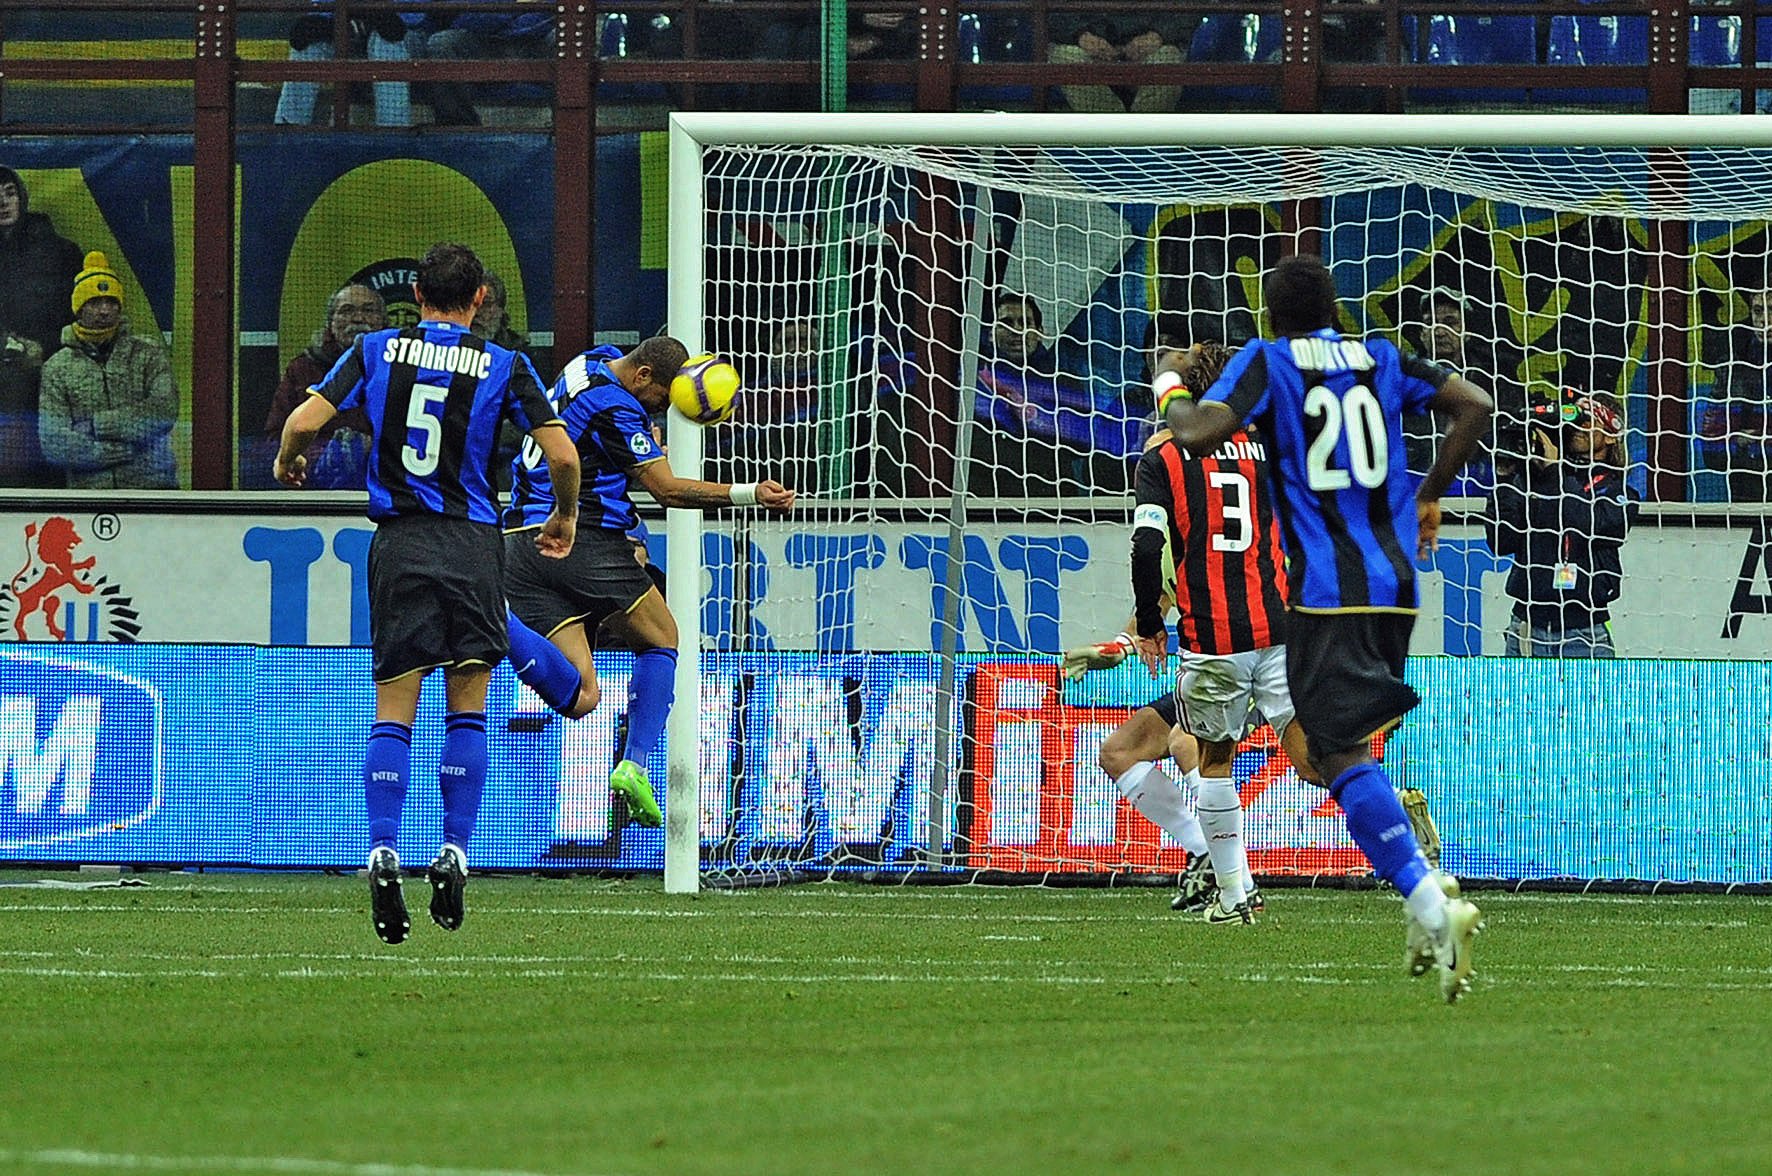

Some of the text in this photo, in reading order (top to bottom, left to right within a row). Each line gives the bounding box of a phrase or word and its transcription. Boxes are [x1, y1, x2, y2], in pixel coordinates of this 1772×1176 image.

[371, 269, 418, 290] INTE
[383, 337, 492, 379] STANKOVIC
[402, 383, 449, 477] 5
[1183, 441, 1266, 461] LDINI
[1304, 385, 1388, 491] 20
[1209, 472, 1253, 552] 3
